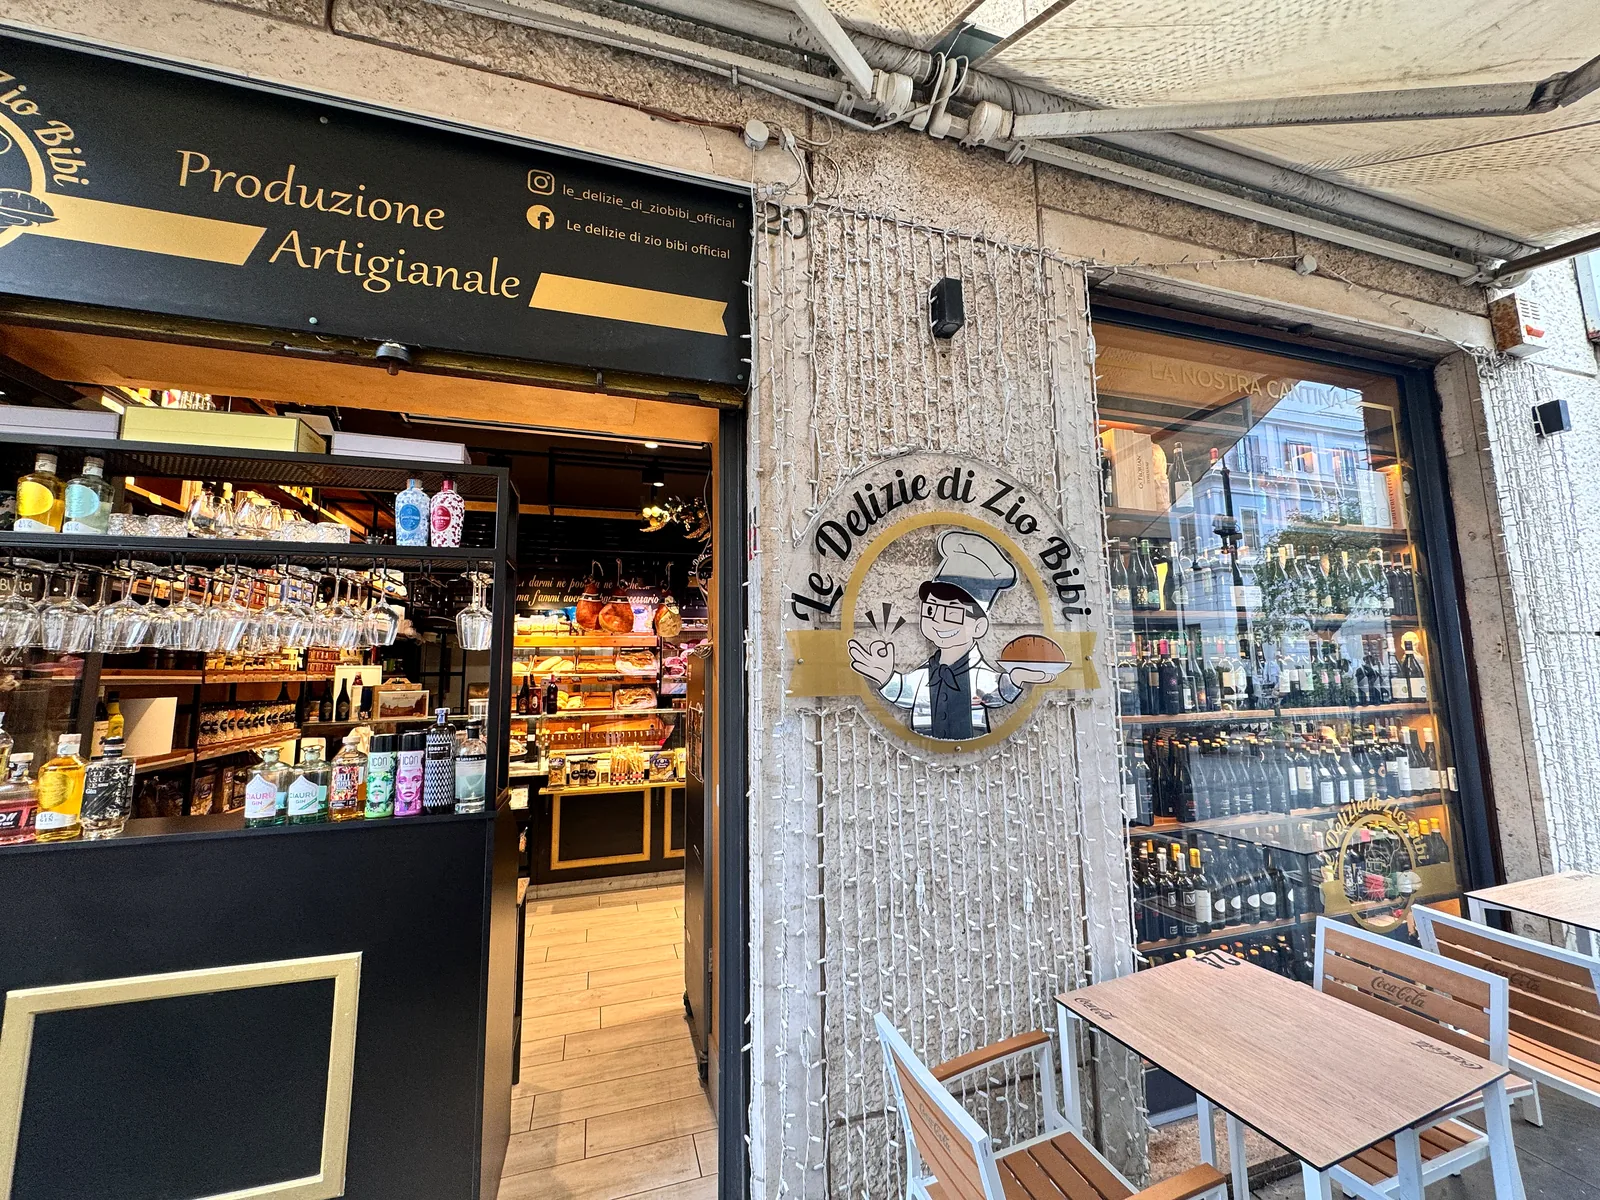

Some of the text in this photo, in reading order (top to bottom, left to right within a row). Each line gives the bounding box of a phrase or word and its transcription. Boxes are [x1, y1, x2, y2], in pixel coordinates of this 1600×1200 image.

[34, 120, 90, 187] Bibi
[177, 150, 446, 231] Produzione
[562, 184, 735, 229] le_delizie_di_ziobibi_official
[269, 230, 521, 299] Artigianale
[566, 219, 730, 260] Le delizie di zio bibi official
[1150, 363, 1344, 409] LA NOSTRA CANTINA
[791, 467, 1092, 622] Le Delizie di Zio Bibi
[1325, 798, 1367, 849] Delizie
[1366, 792, 1381, 812] di
[1382, 795, 1408, 823] Zio
